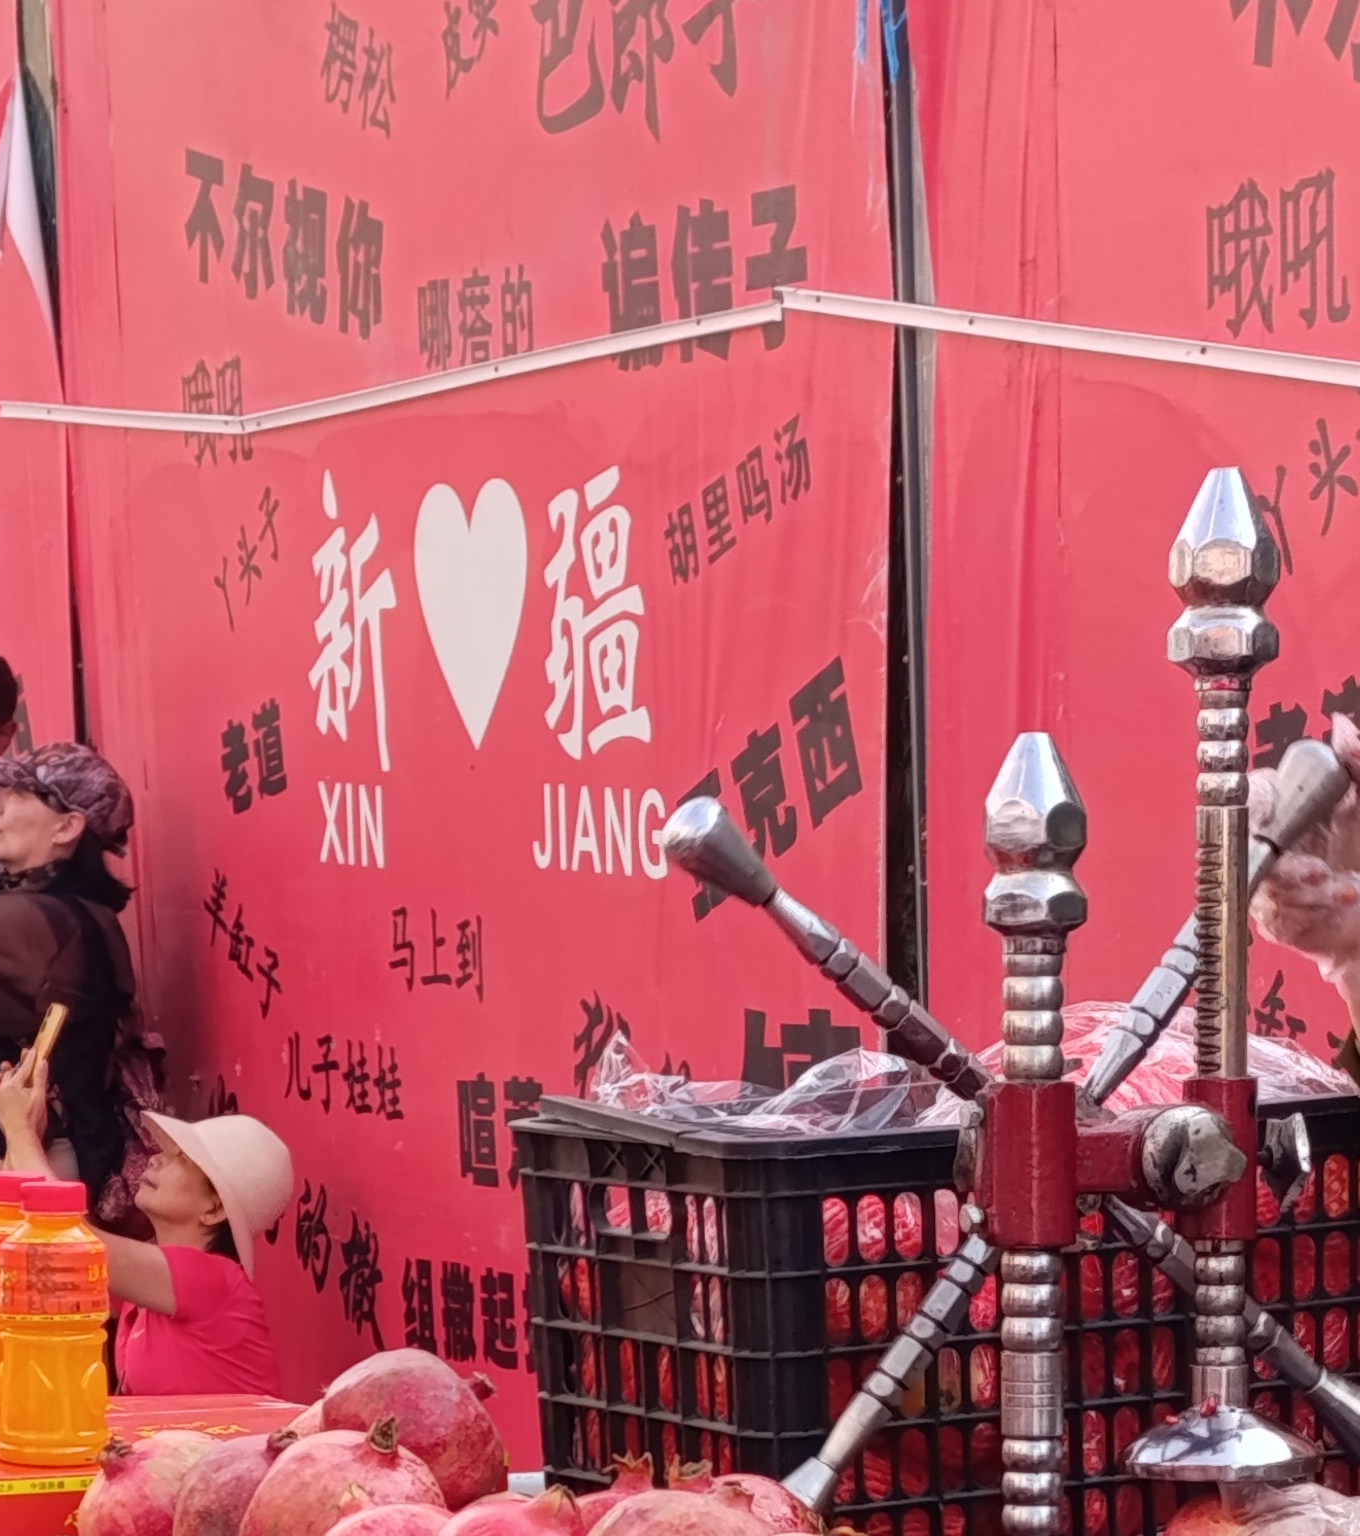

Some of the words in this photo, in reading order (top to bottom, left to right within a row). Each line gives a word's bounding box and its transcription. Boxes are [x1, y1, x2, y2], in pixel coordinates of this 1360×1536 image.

[1204, 168, 1350, 338] 哦吼
[662, 414, 813, 585] 胡里吗汤
[307, 468, 397, 773] 新
[543, 464, 653, 761] 疆
[318, 780, 385, 869] XIN
[532, 783, 669, 880] JIANG
[388, 905, 486, 1004] 马上到
[284, 1031, 405, 1122] 儿子娃娃
